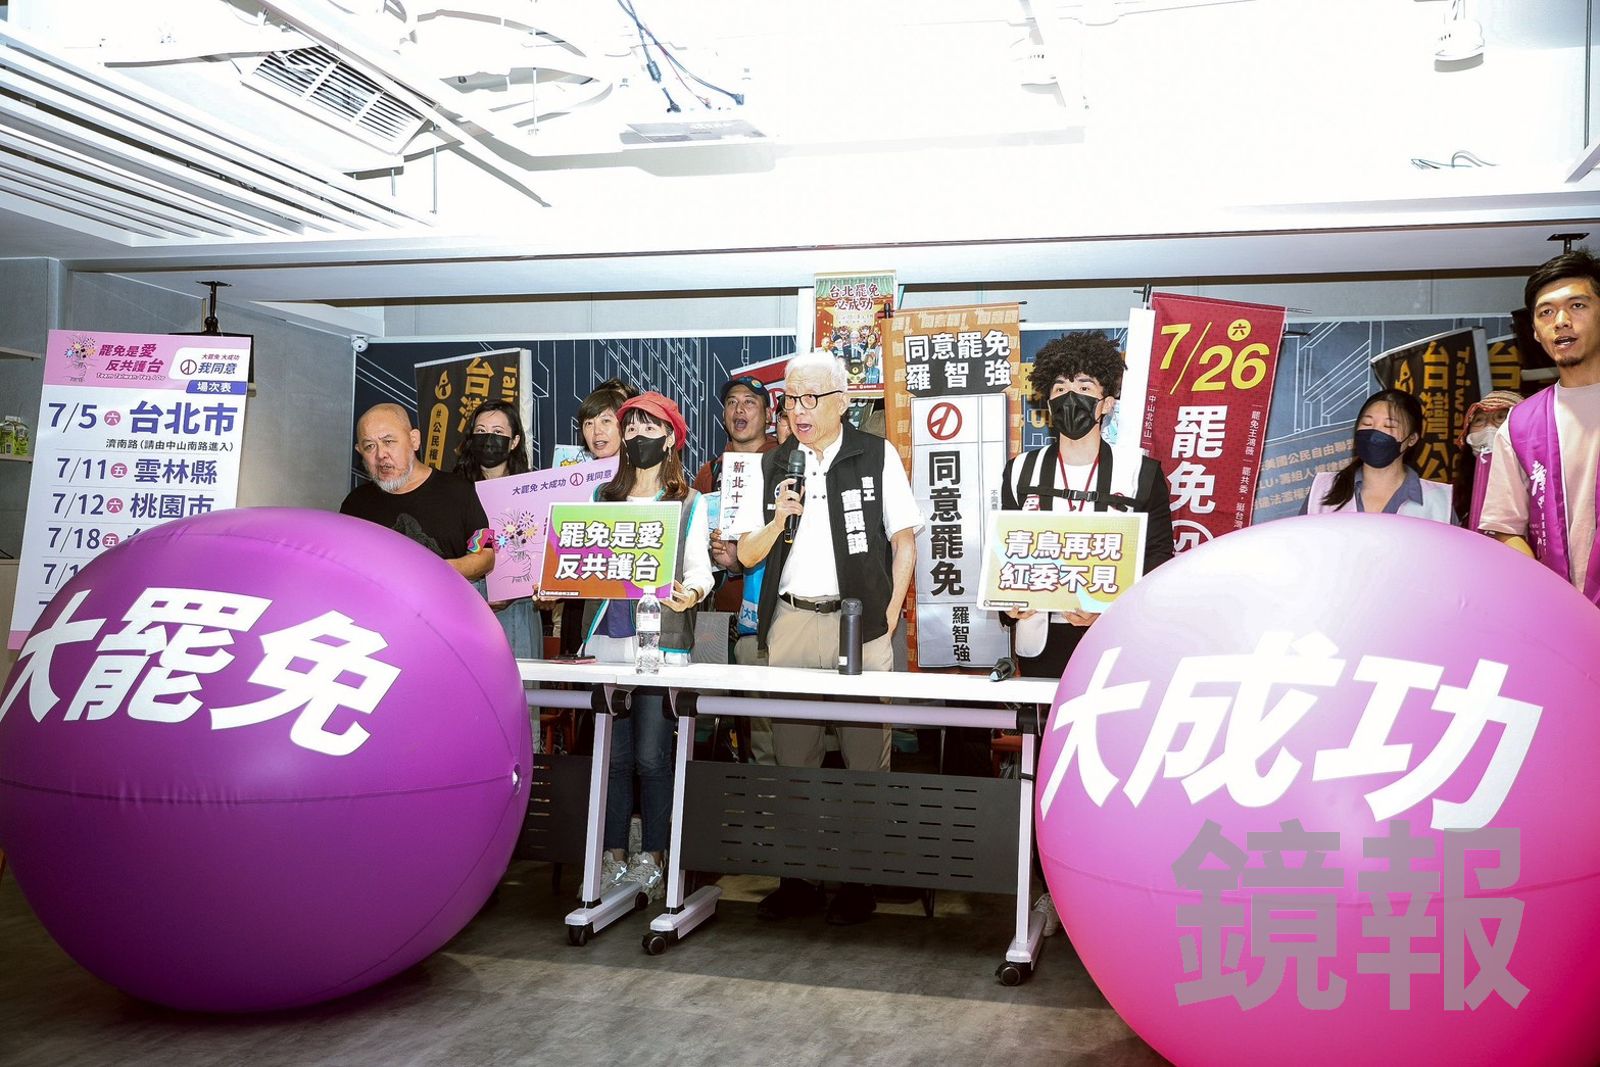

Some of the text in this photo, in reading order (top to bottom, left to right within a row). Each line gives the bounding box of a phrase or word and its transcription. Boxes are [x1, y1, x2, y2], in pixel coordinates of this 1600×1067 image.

[830, 283, 880, 298] 台北罷免
[834, 298, 873, 311] 必成功
[99, 343, 157, 358] 罷免是愛
[903, 330, 1011, 363] 同意罷免
[1159, 321, 1271, 396] 7/26
[105, 358, 164, 373] 反共護台
[197, 361, 238, 375] 我同意
[906, 360, 1012, 391] 羅智強
[196, 380, 232, 394] 場次表
[48, 401, 98, 433] 7/5
[129, 400, 239, 436] 台北市
[56, 457, 107, 482] 7/11
[133, 458, 218, 485] 雲林縣
[1166, 404, 1229, 515] 罷免
[511, 469, 613, 497] 大罷免 大成功 我同意
[52, 493, 105, 519] 7/12
[129, 493, 215, 520] 桃園市
[557, 520, 664, 550] 罷免是愛
[928, 450, 965, 597] 同意罷免
[48, 527, 101, 553] 7/18
[1004, 530, 1123, 561] 青鳥再現
[43, 563, 81, 589] 7/1
[554, 553, 660, 582] 反共護台
[998, 562, 1119, 594] 紅委不見
[951, 606, 971, 663] 羅智強
[0, 587, 402, 757] 大罷免
[1040, 630, 1545, 833] 大成功
